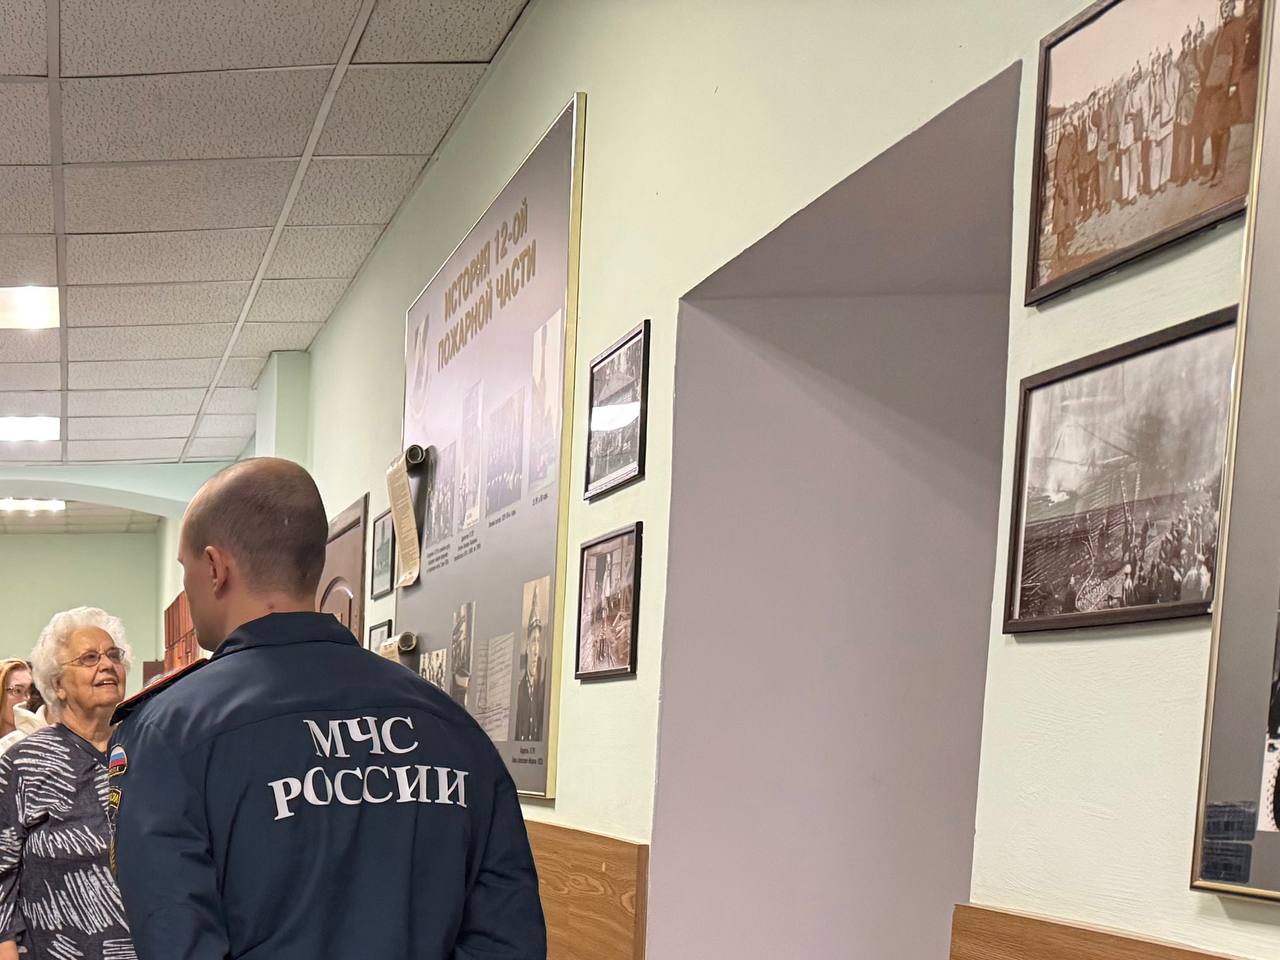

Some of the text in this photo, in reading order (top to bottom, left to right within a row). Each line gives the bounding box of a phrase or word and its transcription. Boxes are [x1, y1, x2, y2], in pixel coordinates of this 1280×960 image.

[444, 196, 529, 323] ИСТОРИЯ 12-ОЙ
[437, 239, 537, 373] ПОЖАРНОЙ ЧАСТИ
[303, 715, 419, 758] МЧС
[267, 764, 470, 821] РОССИИ
